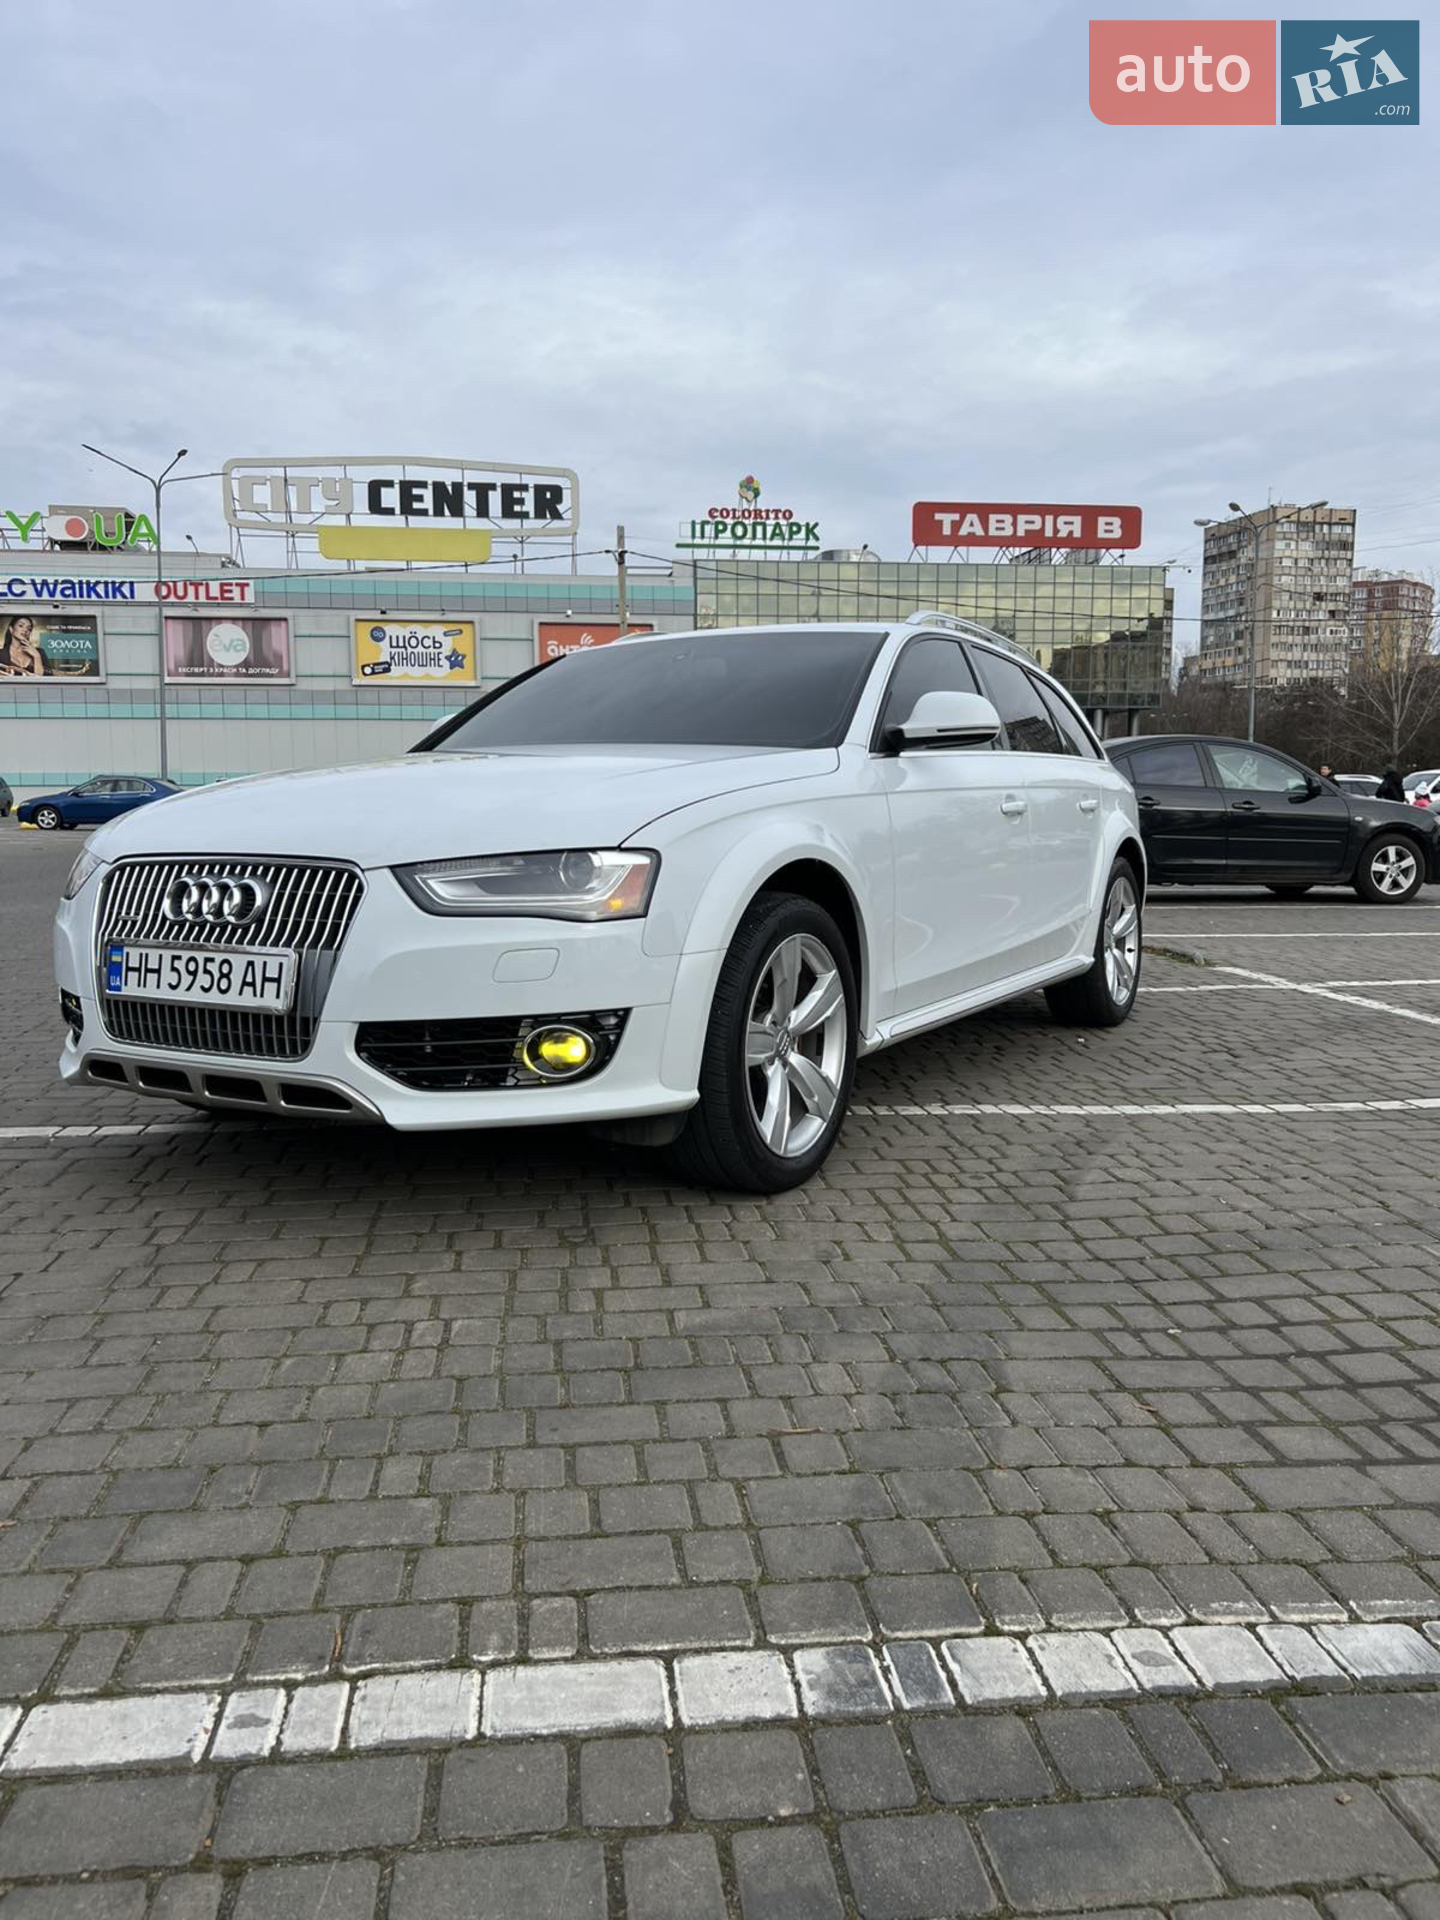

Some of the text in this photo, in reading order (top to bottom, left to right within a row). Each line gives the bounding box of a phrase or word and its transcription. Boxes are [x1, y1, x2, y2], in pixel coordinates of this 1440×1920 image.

[238, 475, 564, 520] CITY CENTER
[708, 507, 794, 520] COLORITO
[690, 520, 820, 542] ІГРОПАРК
[934, 512, 1123, 539] ТАВРІЯ В
[154, 580, 251, 602] OUTLET
[47, 639, 93, 650] ЗОЛОТА
[389, 651, 444, 668] КІНОШНЕ
[110, 976, 121, 987] UA
[167, 954, 233, 996] 5958
